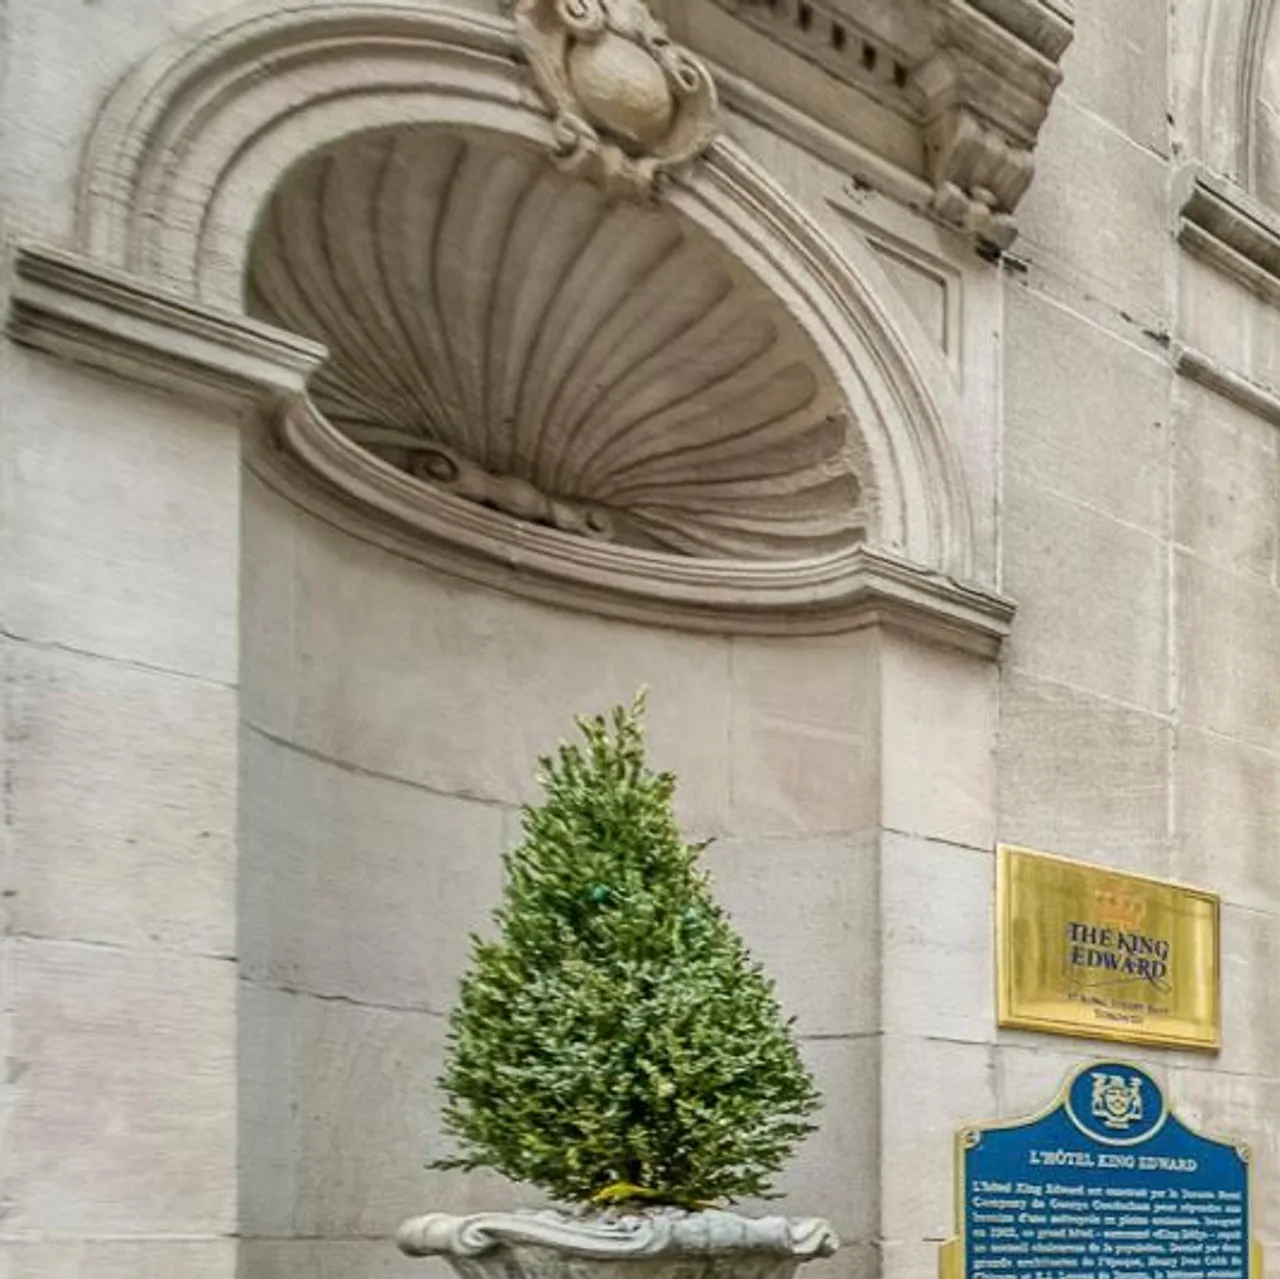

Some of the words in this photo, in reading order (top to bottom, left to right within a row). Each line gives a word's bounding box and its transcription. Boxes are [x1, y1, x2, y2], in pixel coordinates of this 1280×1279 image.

[1068, 922, 1113, 947] THE
[1117, 932, 1170, 960] KING
[1071, 946, 1168, 985] EDWARD
[1097, 1154, 1135, 1170] KING
[1138, 1157, 1199, 1173] EDWARD
